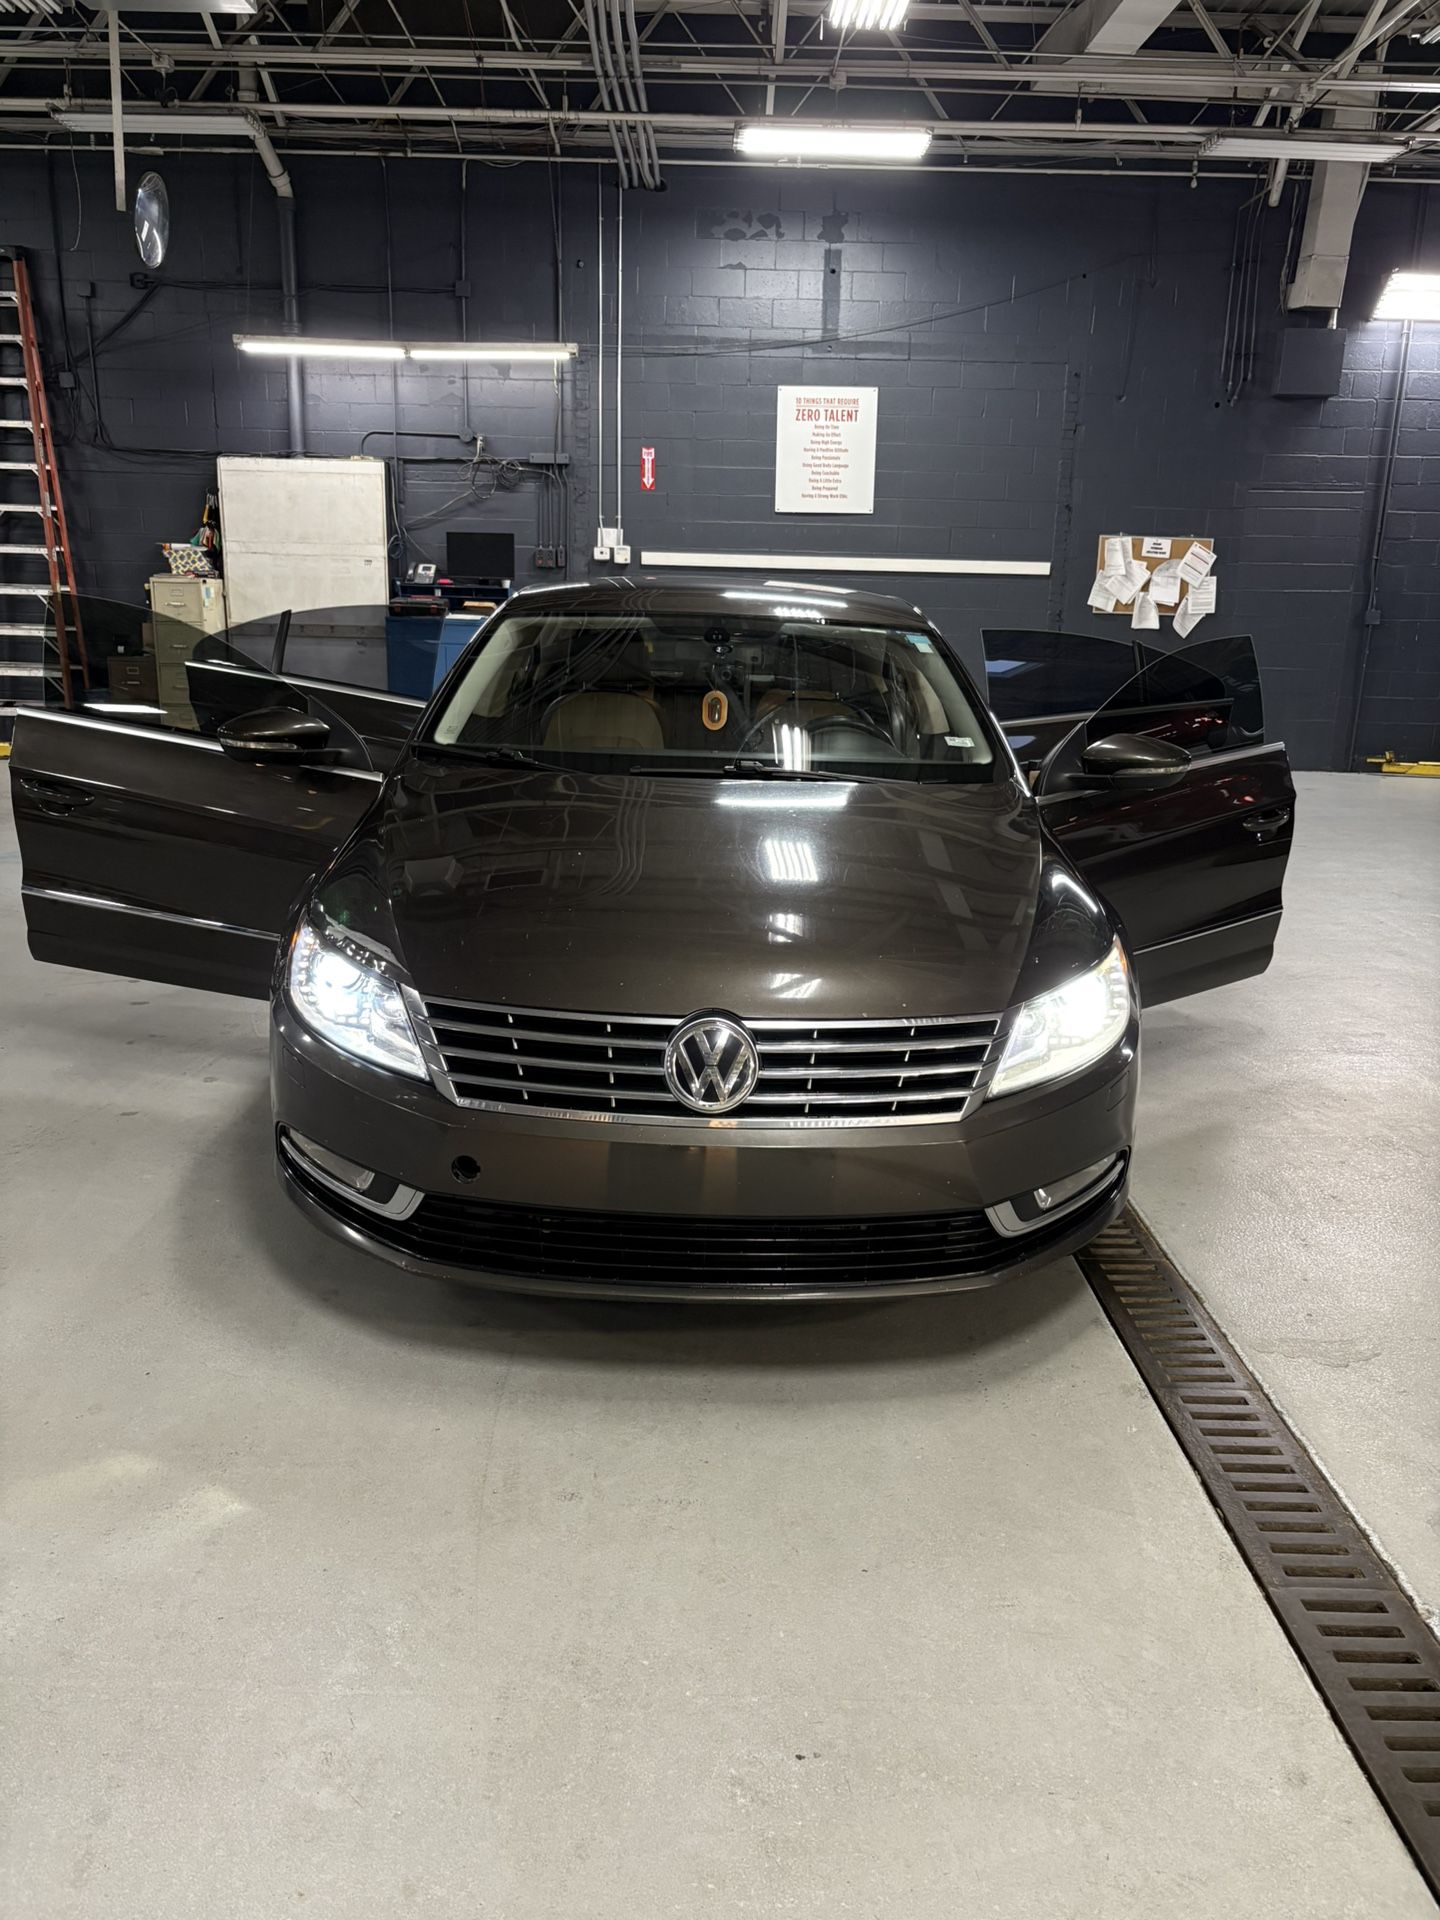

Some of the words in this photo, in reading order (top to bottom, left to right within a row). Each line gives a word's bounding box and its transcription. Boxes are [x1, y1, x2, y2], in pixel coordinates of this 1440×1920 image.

[795, 409, 820, 421] ZERO
[824, 409, 859, 422] TALENT
[675, 1026, 750, 1104] VW
